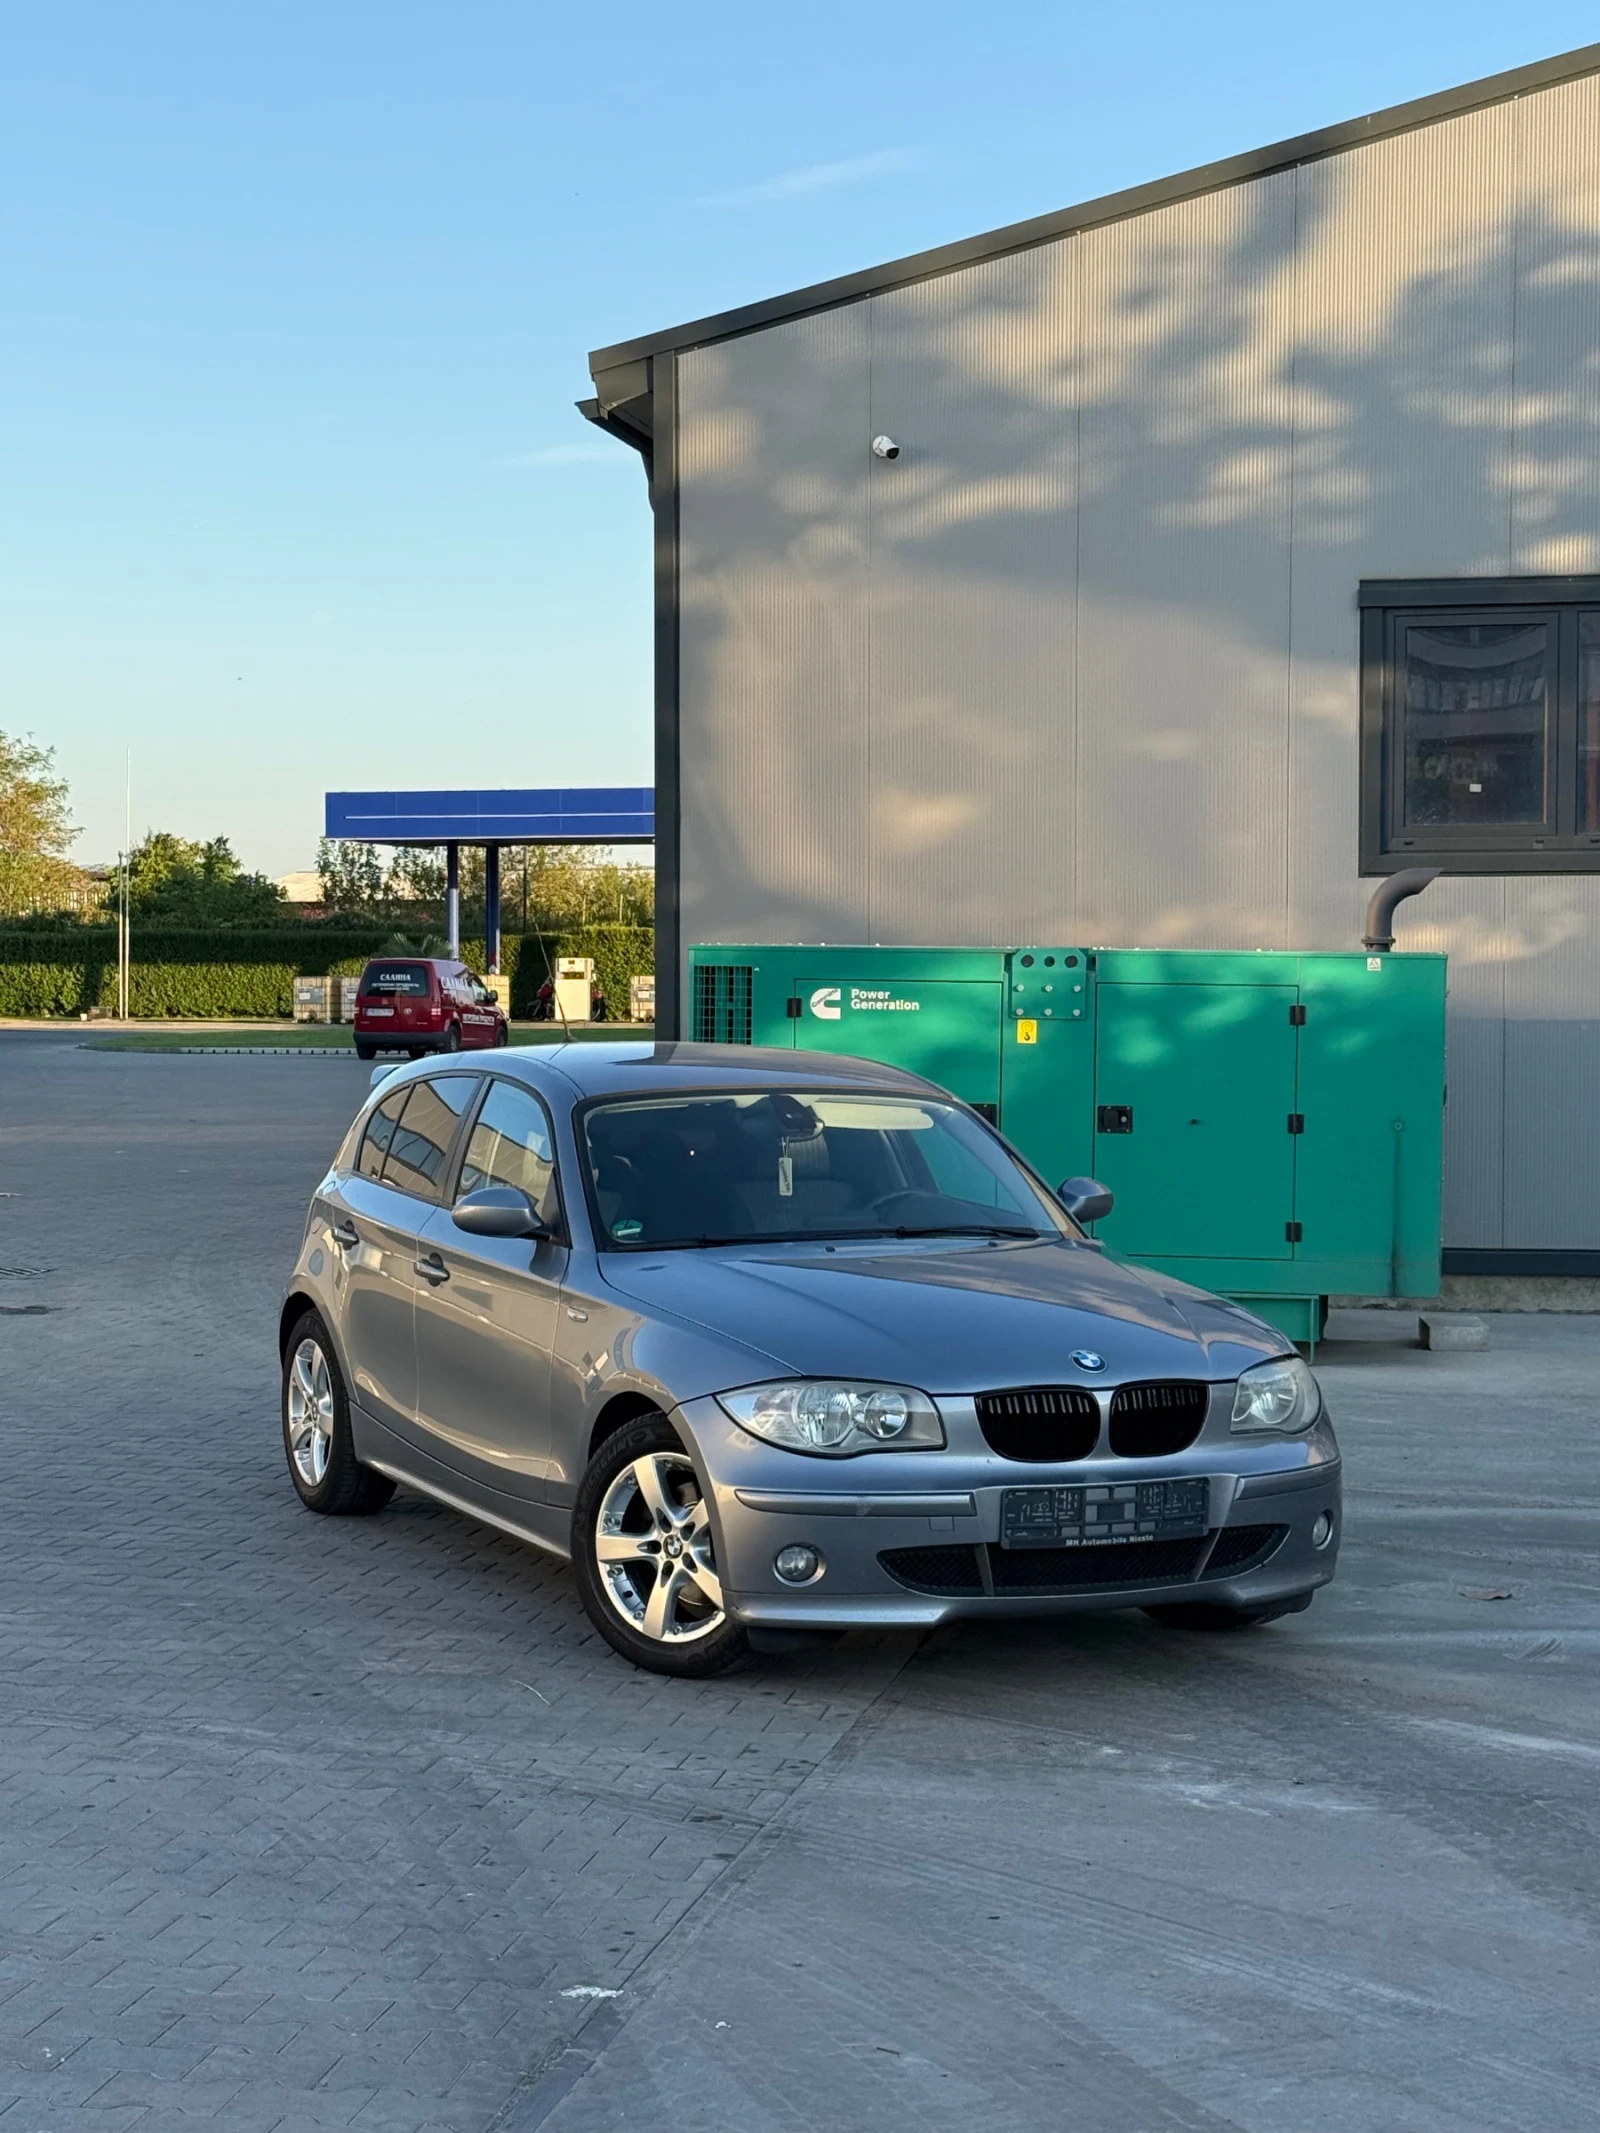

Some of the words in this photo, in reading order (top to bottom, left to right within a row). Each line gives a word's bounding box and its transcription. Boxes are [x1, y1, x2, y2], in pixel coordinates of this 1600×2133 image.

[851, 988, 891, 999] Power
[851, 999, 920, 1011] Generation
[1081, 1536, 1128, 1546] Automobile
